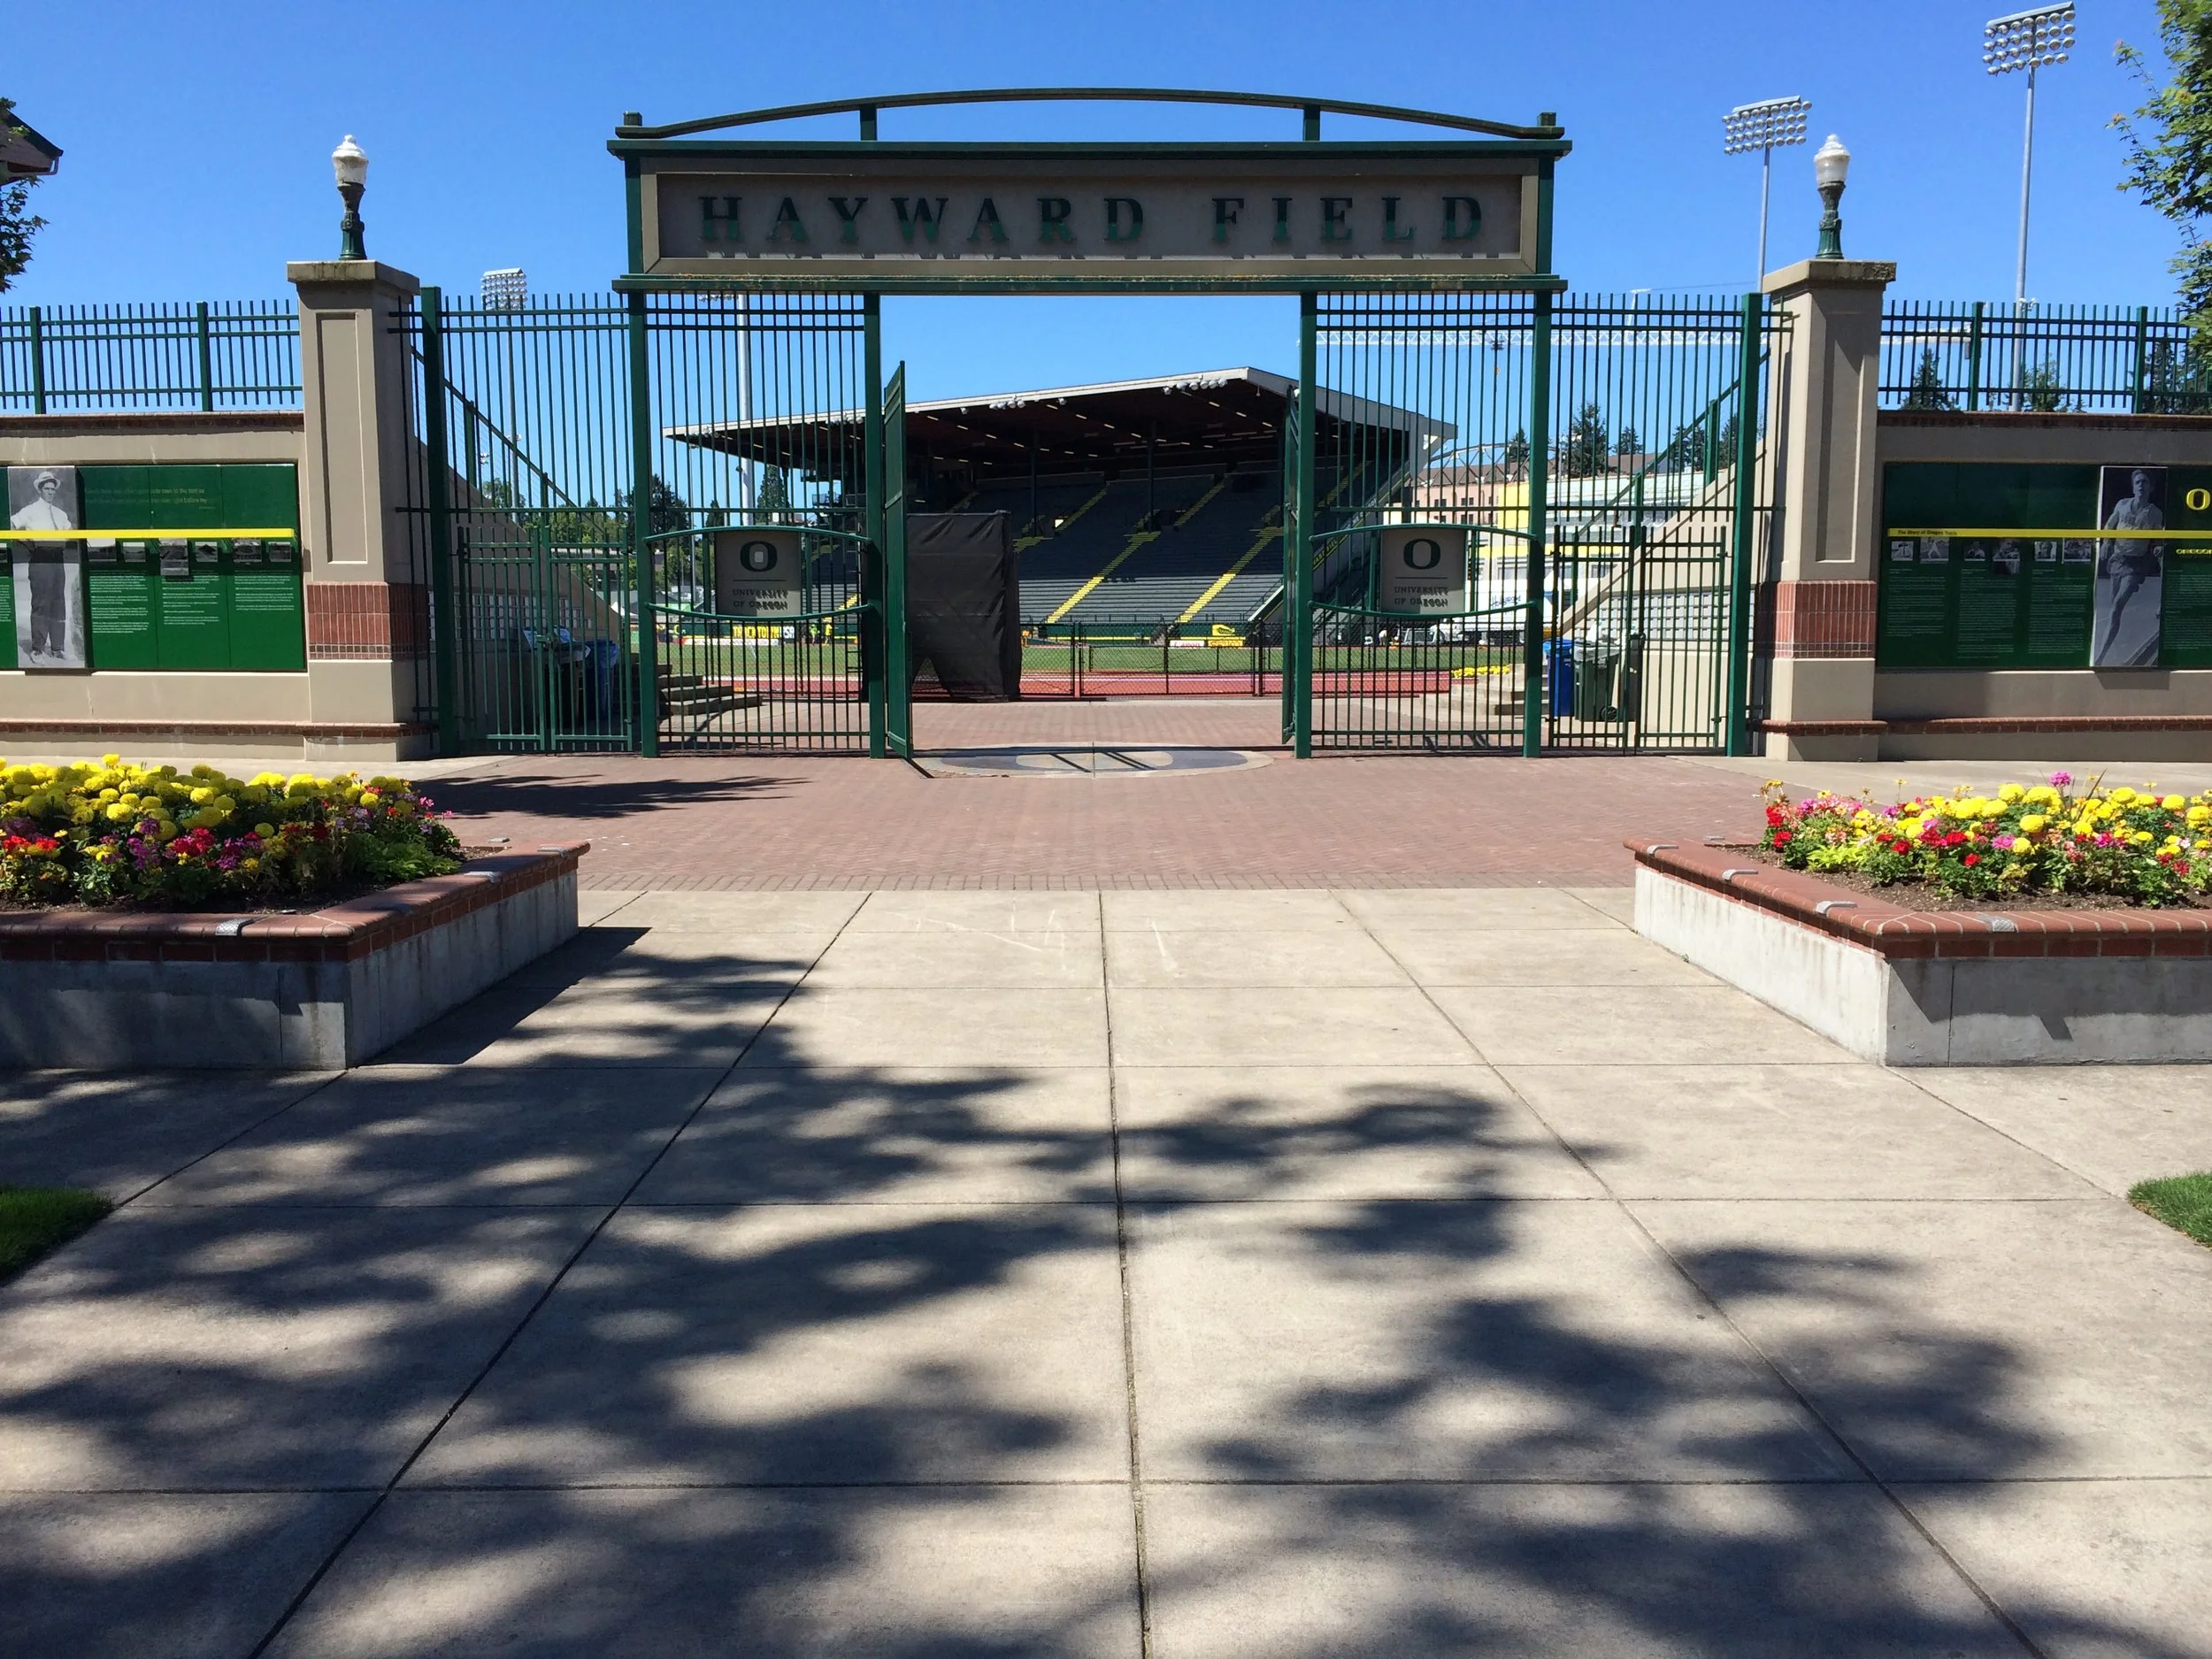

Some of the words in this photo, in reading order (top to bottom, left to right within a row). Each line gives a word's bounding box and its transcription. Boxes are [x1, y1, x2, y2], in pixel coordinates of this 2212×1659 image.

[698, 196, 1144, 243] HAYWARD
[1211, 196, 1482, 242] FIELD
[2186, 488, 2211, 511] O
[740, 541, 778, 572] O
[1403, 538, 1441, 570] O
[733, 588, 787, 599] UNIVERSITY
[1394, 586, 1448, 595] UNIVERSITY
[749, 601, 787, 611] OREGON
[1409, 597, 1448, 607] OREGON
